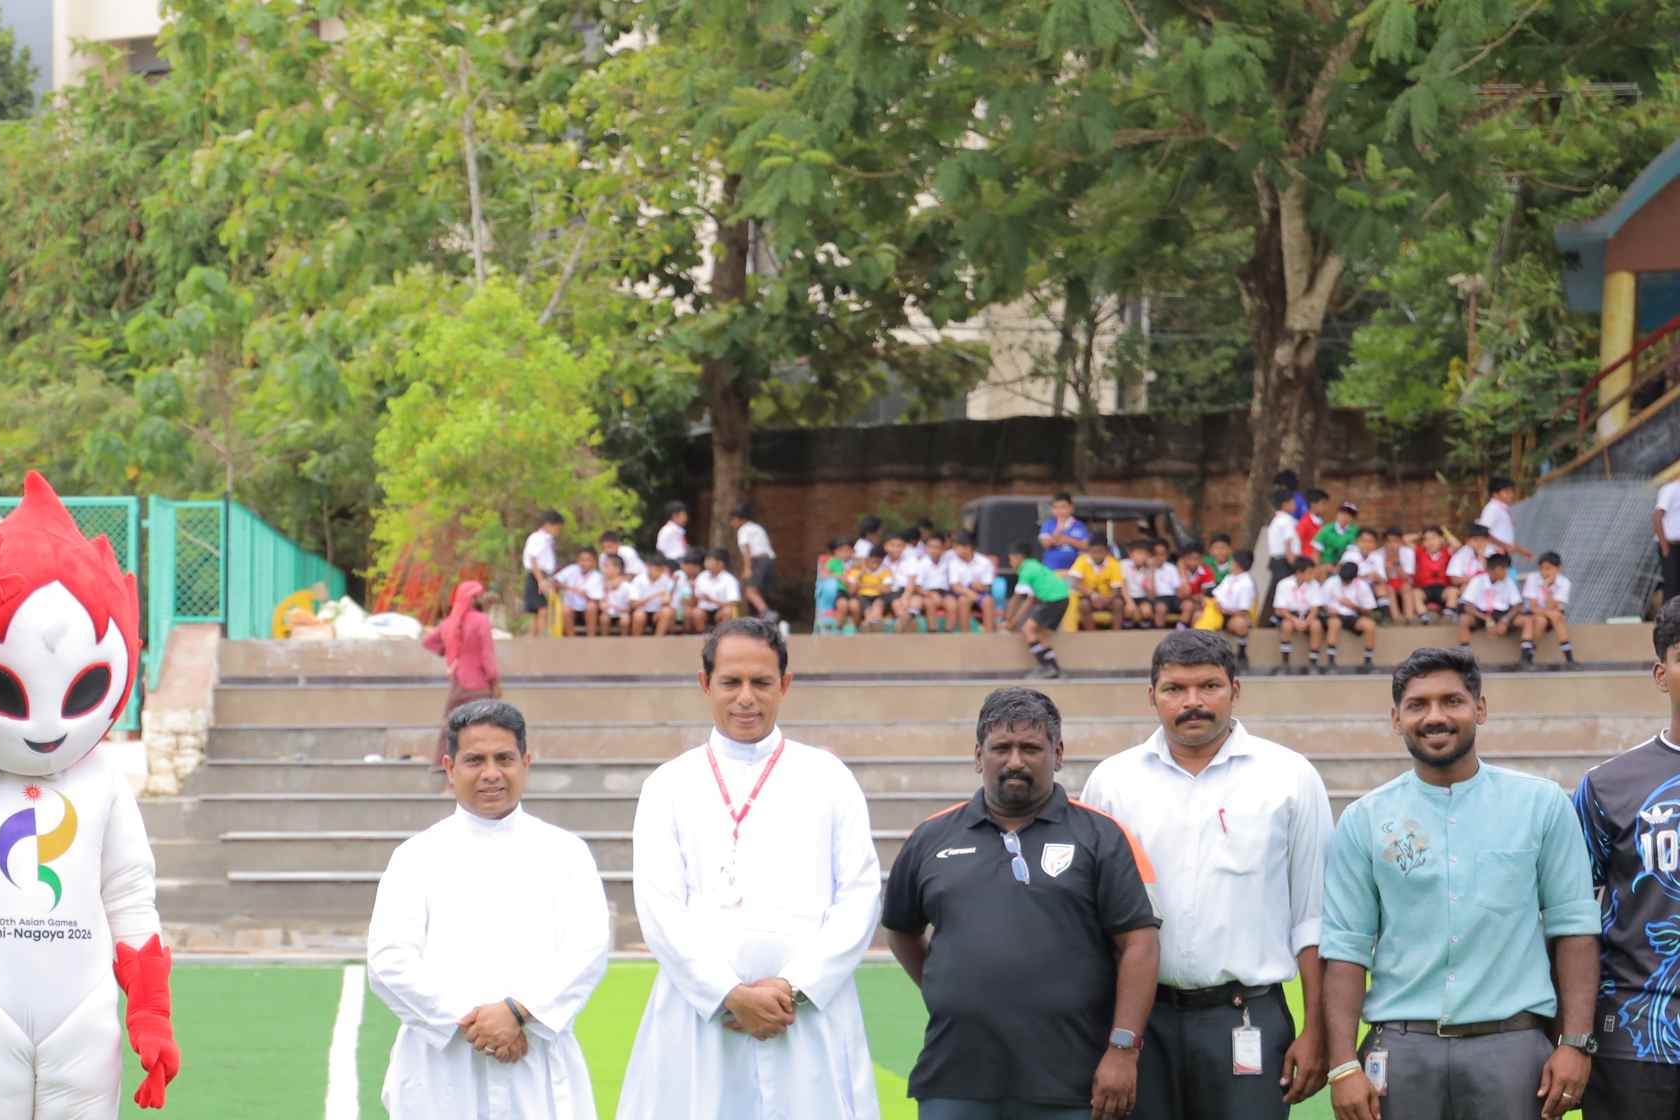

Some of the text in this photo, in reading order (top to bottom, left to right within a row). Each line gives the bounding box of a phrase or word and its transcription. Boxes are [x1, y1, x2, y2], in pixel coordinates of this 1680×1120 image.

[1640, 829, 1679, 873] 10
[19, 918, 45, 927] Asian
[48, 918, 78, 927] Games
[68, 928, 92, 940] 2026
